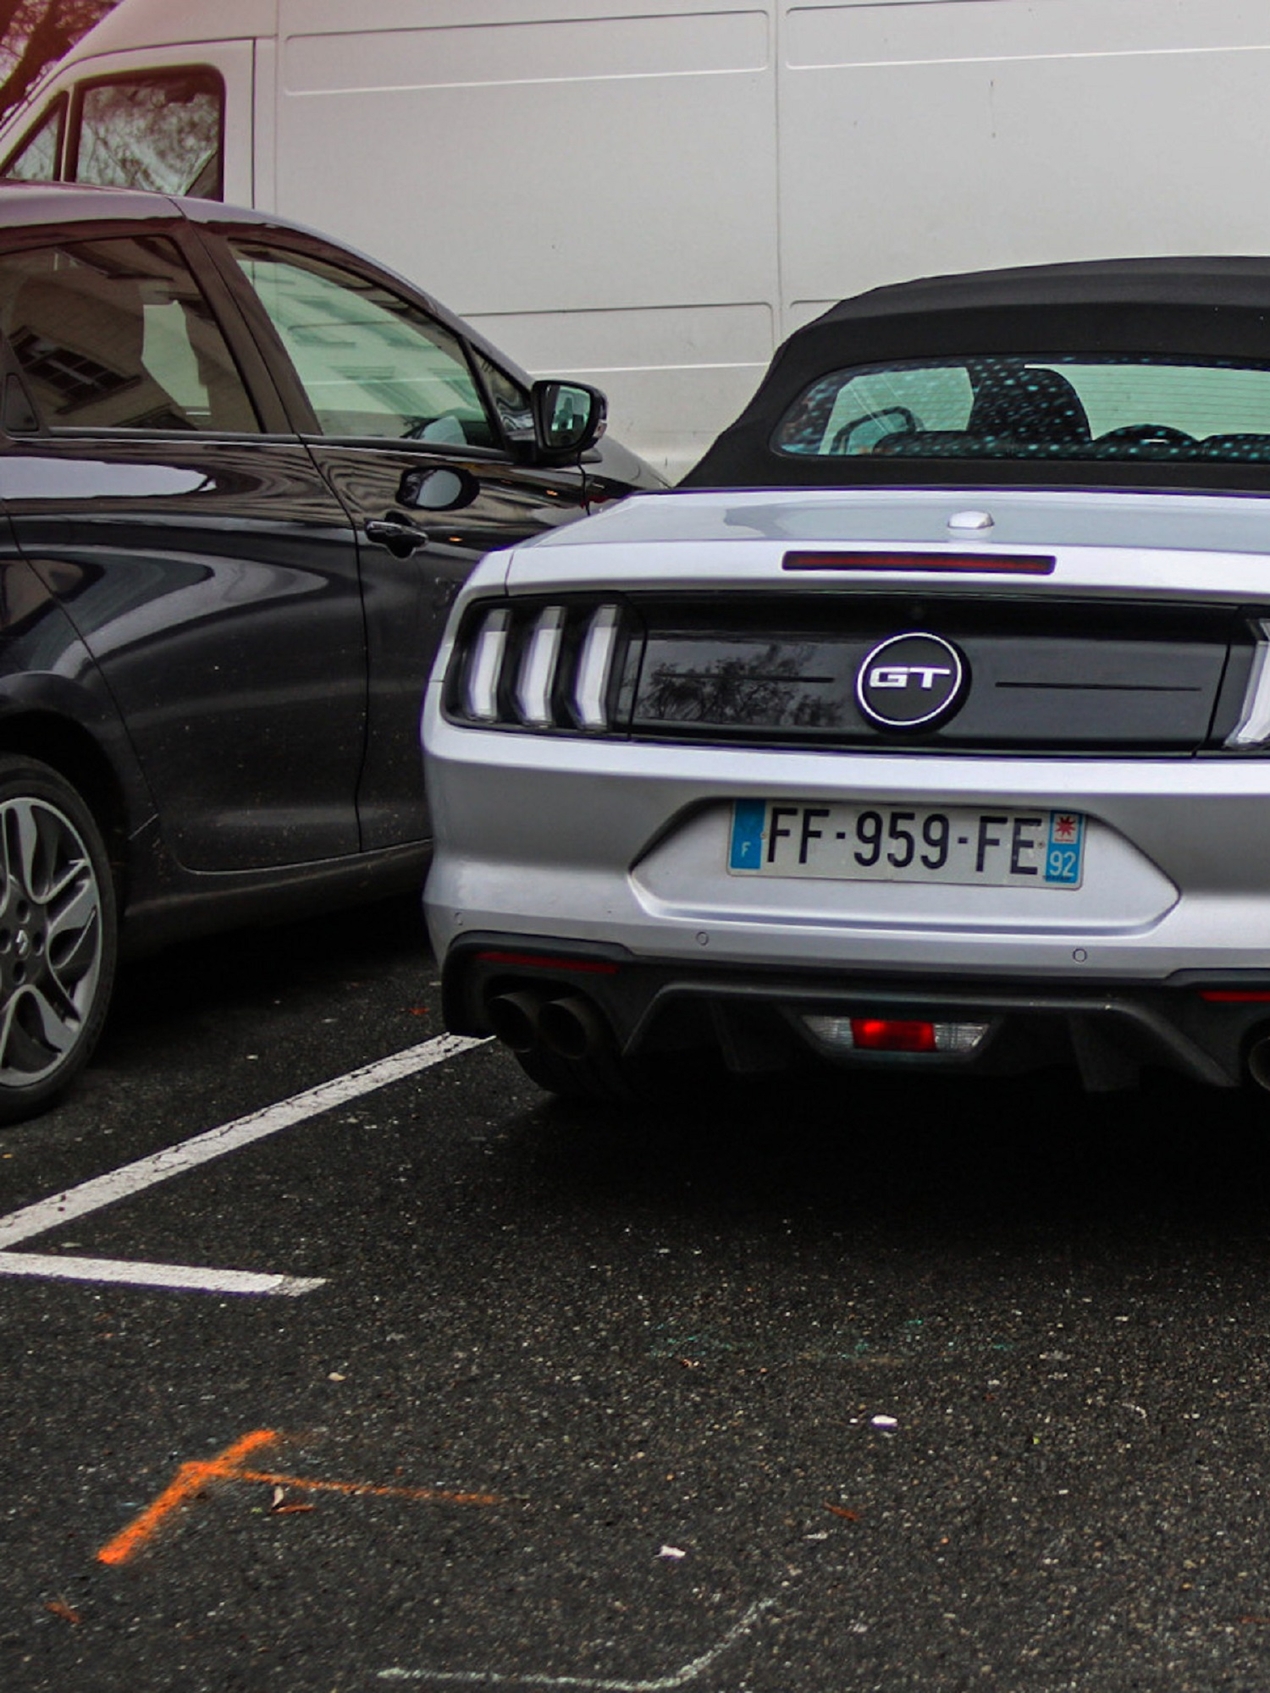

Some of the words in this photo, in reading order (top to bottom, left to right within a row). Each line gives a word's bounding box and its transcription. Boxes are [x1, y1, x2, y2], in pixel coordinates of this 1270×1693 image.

[870, 666, 951, 688] GT
[741, 841, 751, 857] F
[767, 807, 1043, 876] FF-959-FE
[1049, 850, 1076, 877] 92
